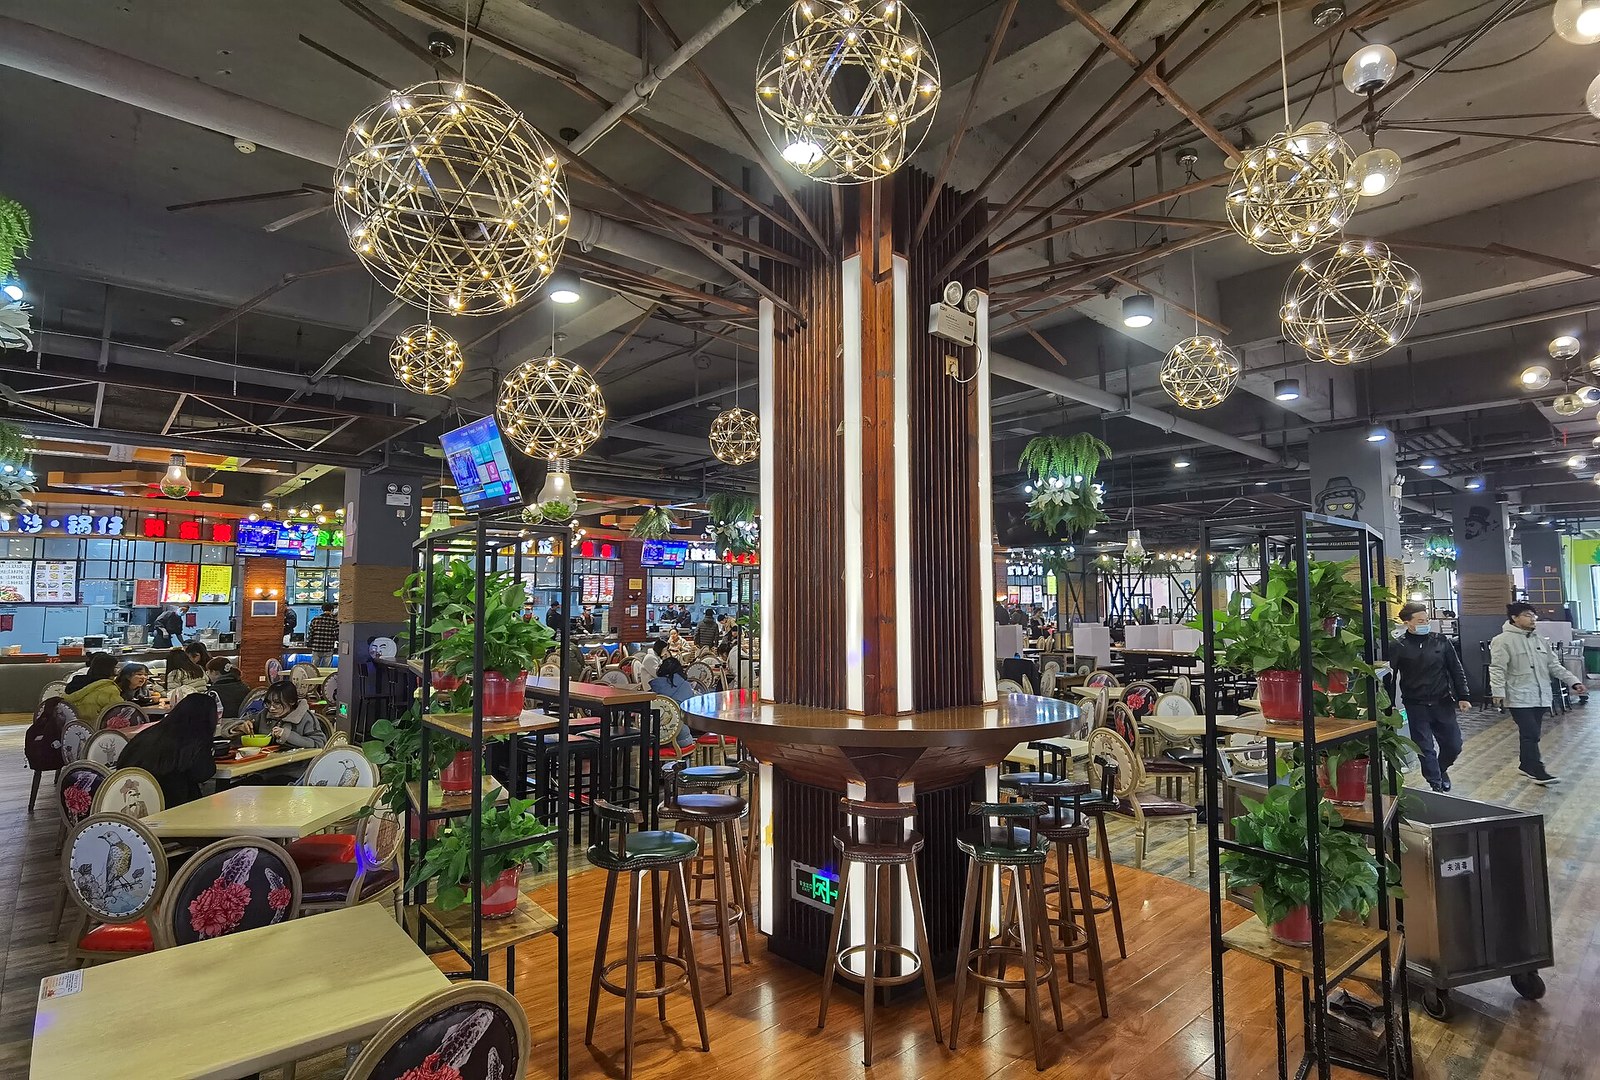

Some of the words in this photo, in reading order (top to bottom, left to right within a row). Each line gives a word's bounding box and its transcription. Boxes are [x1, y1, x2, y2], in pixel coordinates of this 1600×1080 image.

[0, 513, 124, 535] 沙·锅仔
[1447, 861, 1468, 872] 未消毒
